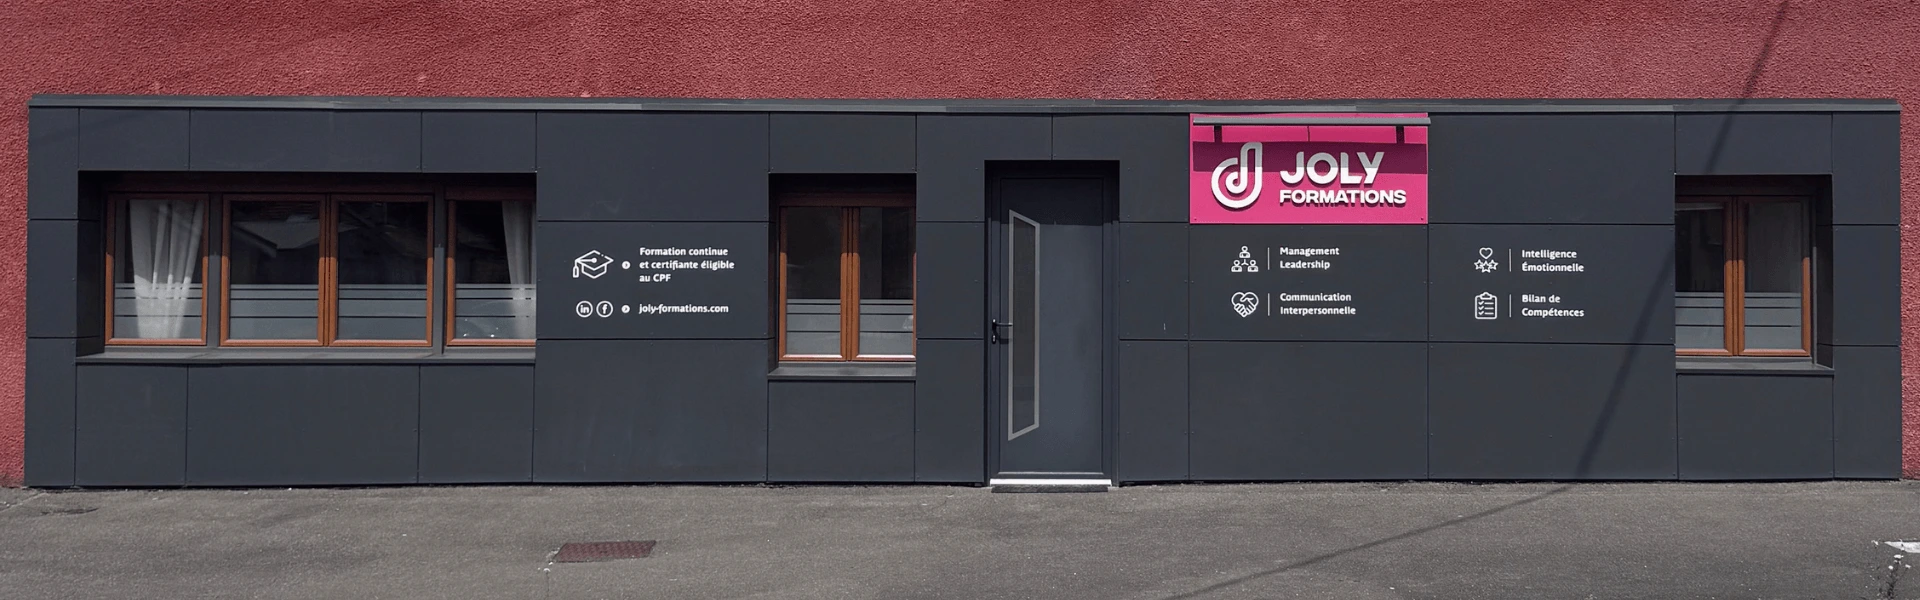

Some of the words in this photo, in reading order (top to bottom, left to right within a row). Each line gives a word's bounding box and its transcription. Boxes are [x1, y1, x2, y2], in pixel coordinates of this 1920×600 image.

[1279, 151, 1385, 185] JOLY
[1279, 189, 1407, 204] FORMATIONS
[639, 247, 686, 256] Formation
[688, 247, 729, 256] continue
[1279, 247, 1340, 257] Management
[1521, 249, 1578, 260] Intelligence
[639, 260, 650, 269] et
[651, 260, 699, 271] certifiante
[700, 260, 735, 271] éligible
[1279, 260, 1331, 270] Leadership
[1521, 261, 1585, 272] Émotionnelle
[652, 273, 672, 282] CPF
[1279, 292, 1352, 302] Communication
[1521, 294, 1546, 303] Bilan
[1548, 294, 1561, 303] de
[638, 304, 729, 315] joly-formations.com
[1280, 306, 1357, 317] Interpersonnelle
[1521, 307, 1585, 318] Compétences
